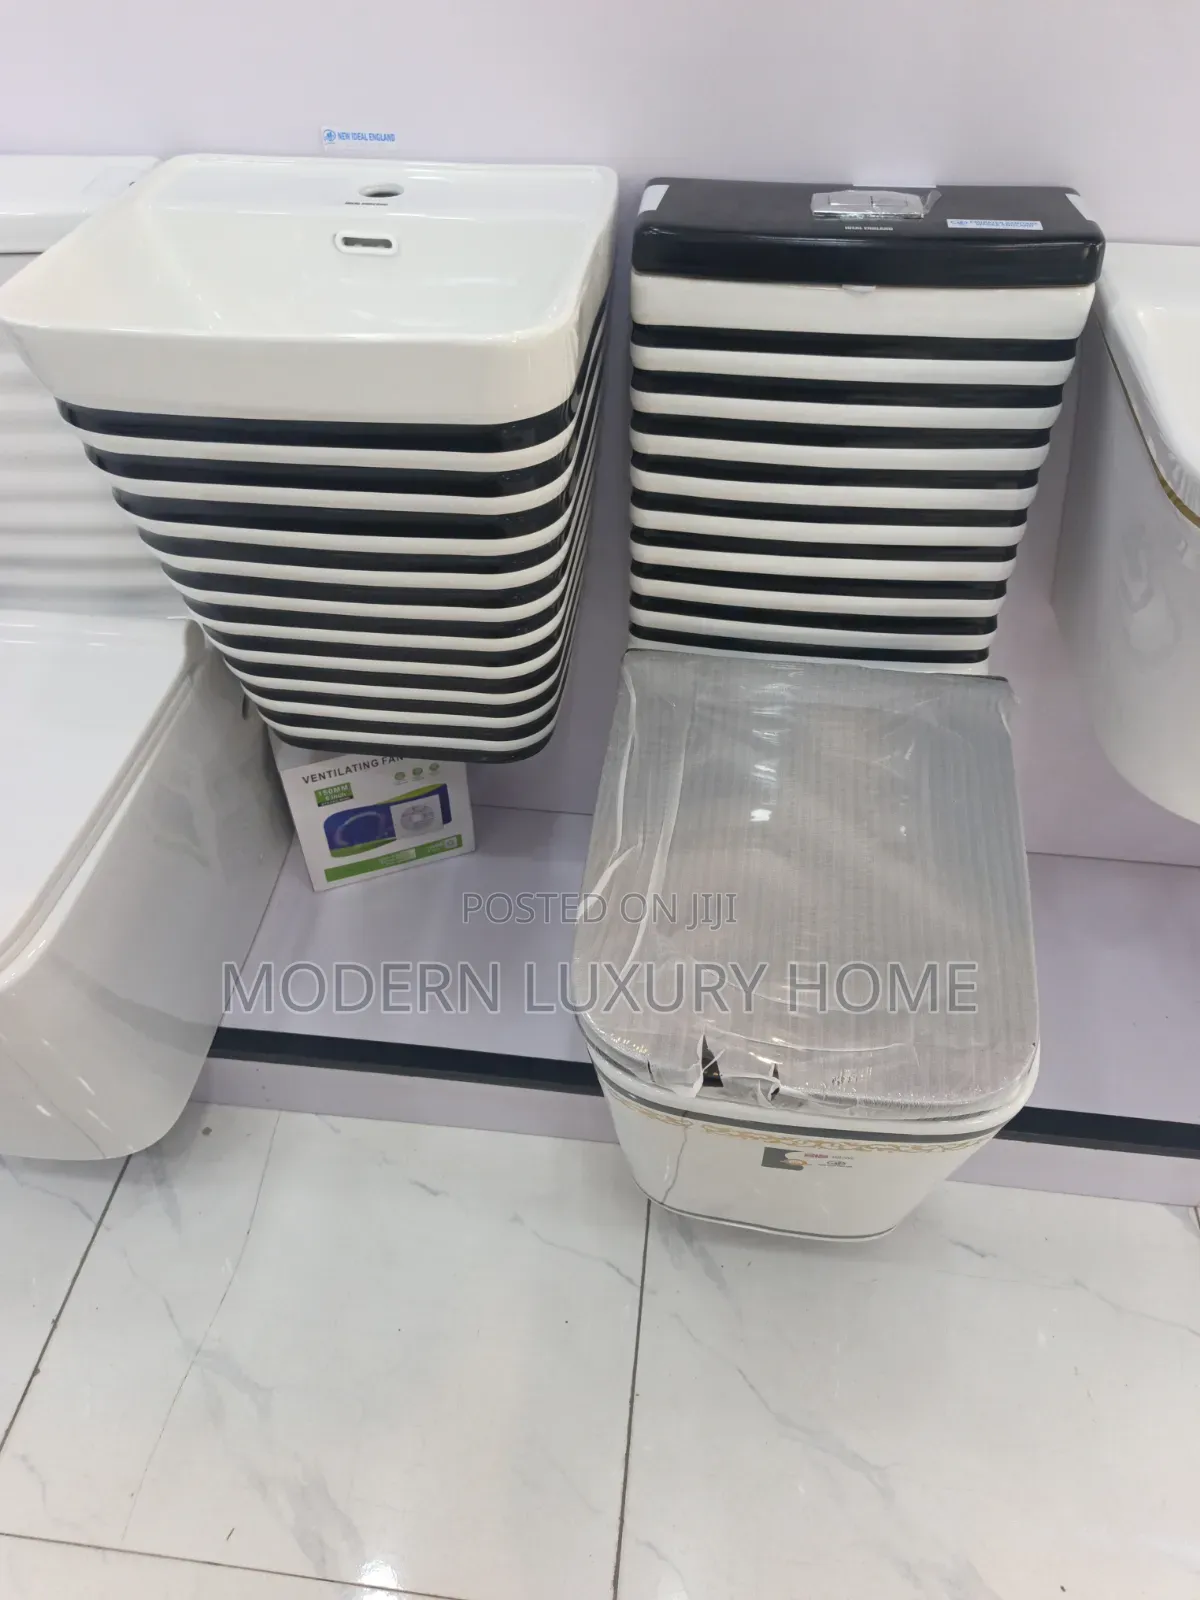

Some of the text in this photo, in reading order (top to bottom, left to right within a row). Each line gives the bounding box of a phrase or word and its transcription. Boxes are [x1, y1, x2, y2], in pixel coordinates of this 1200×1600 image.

[337, 131, 396, 142] NEW IDEAL ENGLAND
[302, 759, 379, 784] VENTILATING
